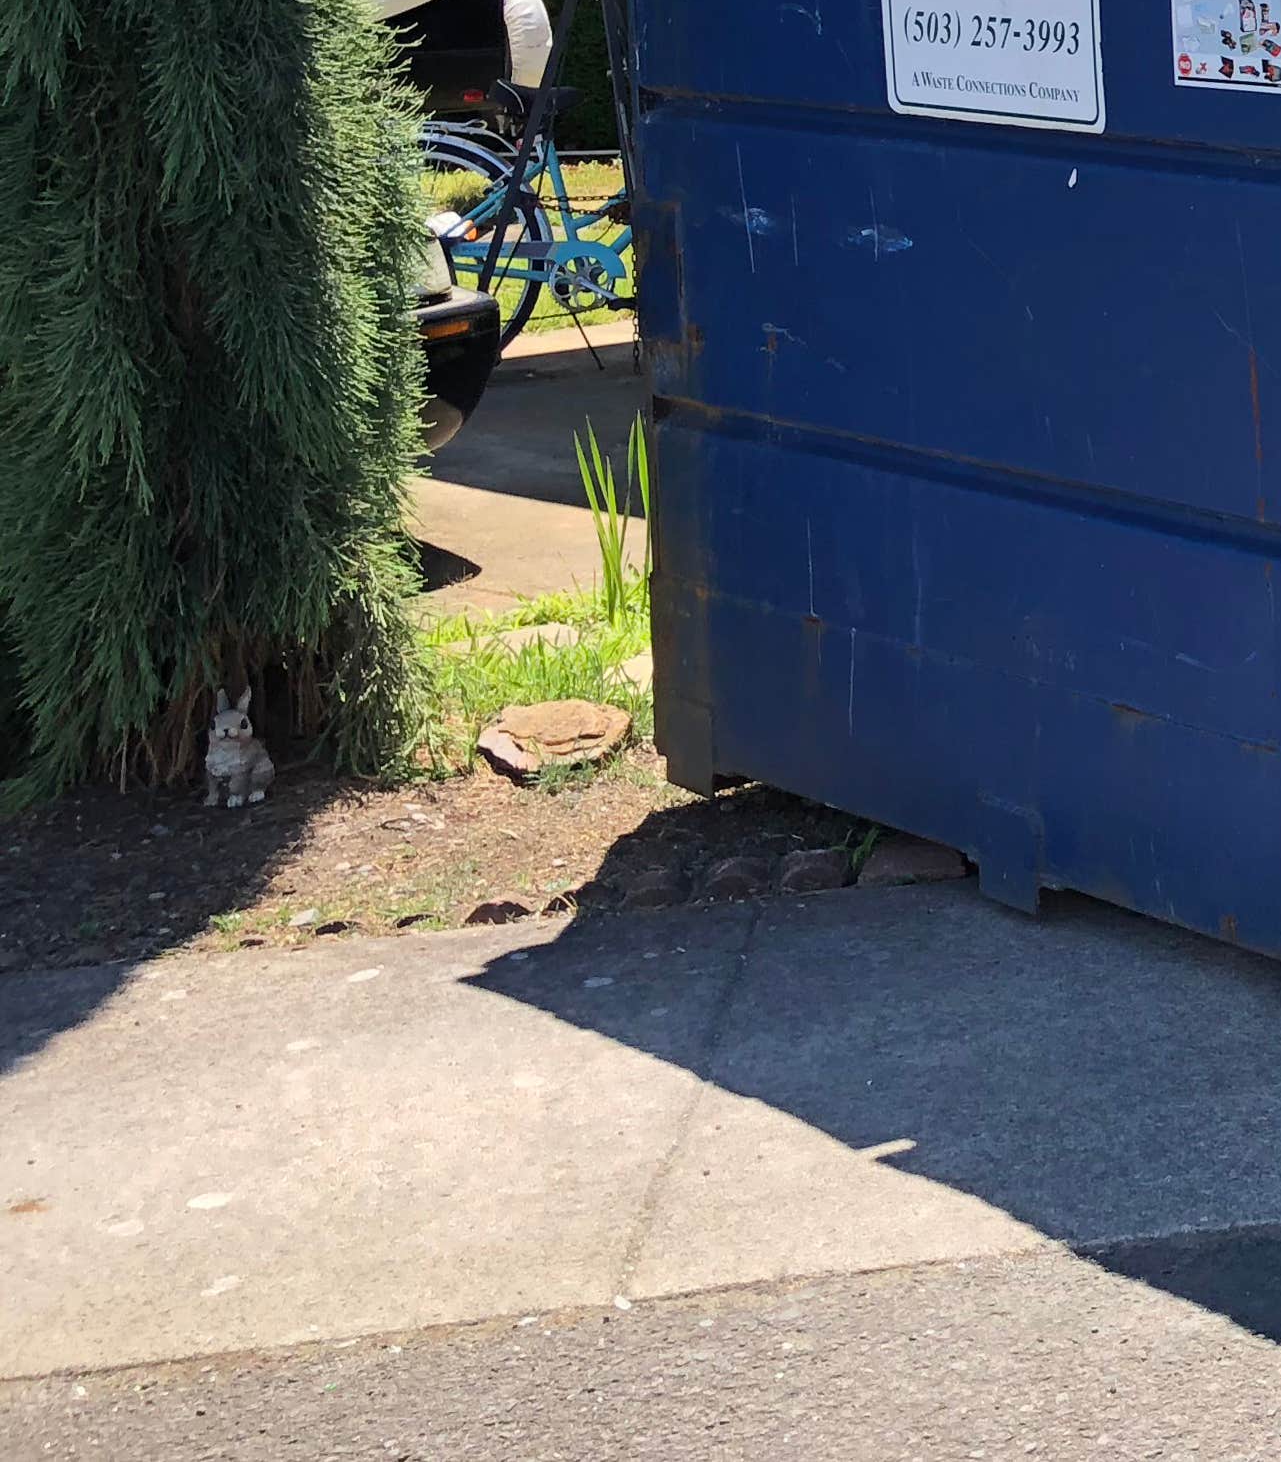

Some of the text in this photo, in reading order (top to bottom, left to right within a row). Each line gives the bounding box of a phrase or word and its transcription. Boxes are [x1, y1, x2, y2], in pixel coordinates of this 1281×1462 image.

[903, 6, 1080, 56] (503) 257-3993
[912, 71, 1080, 103] A WASTE CONNECTIONS COMPANY
